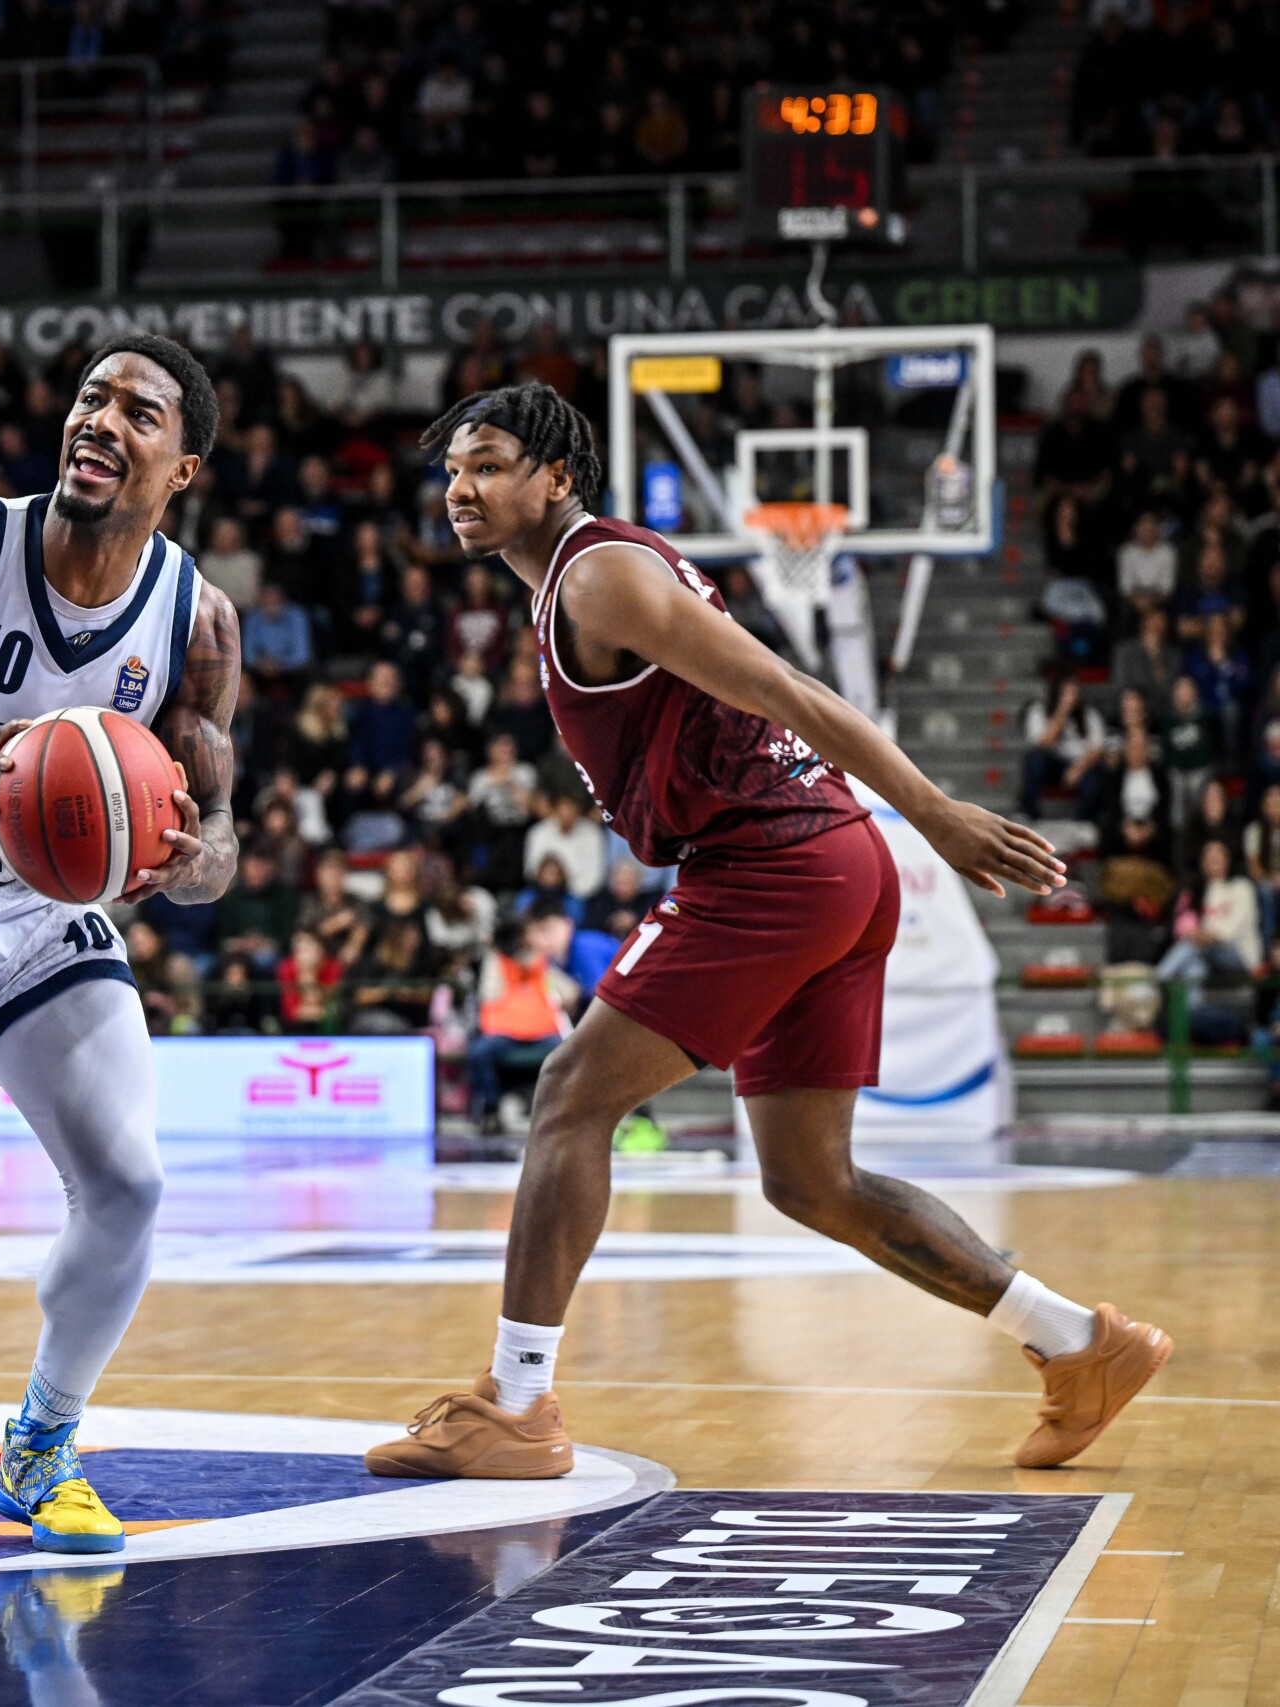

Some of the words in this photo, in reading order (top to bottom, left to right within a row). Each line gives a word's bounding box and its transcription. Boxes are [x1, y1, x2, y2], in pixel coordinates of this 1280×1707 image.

[781, 94, 877, 135] 4:33
[441, 293, 573, 343] CON
[585, 288, 715, 335] UNA
[897, 278, 1099, 324] GREEN
[121, 679, 143, 692] LBA
[75, 794, 89, 837] APPROVED
[110, 792, 125, 833] BG4500
[63, 911, 115, 950] 10
[615, 922, 664, 977] 1
[248, 1040, 382, 1105] EYE
